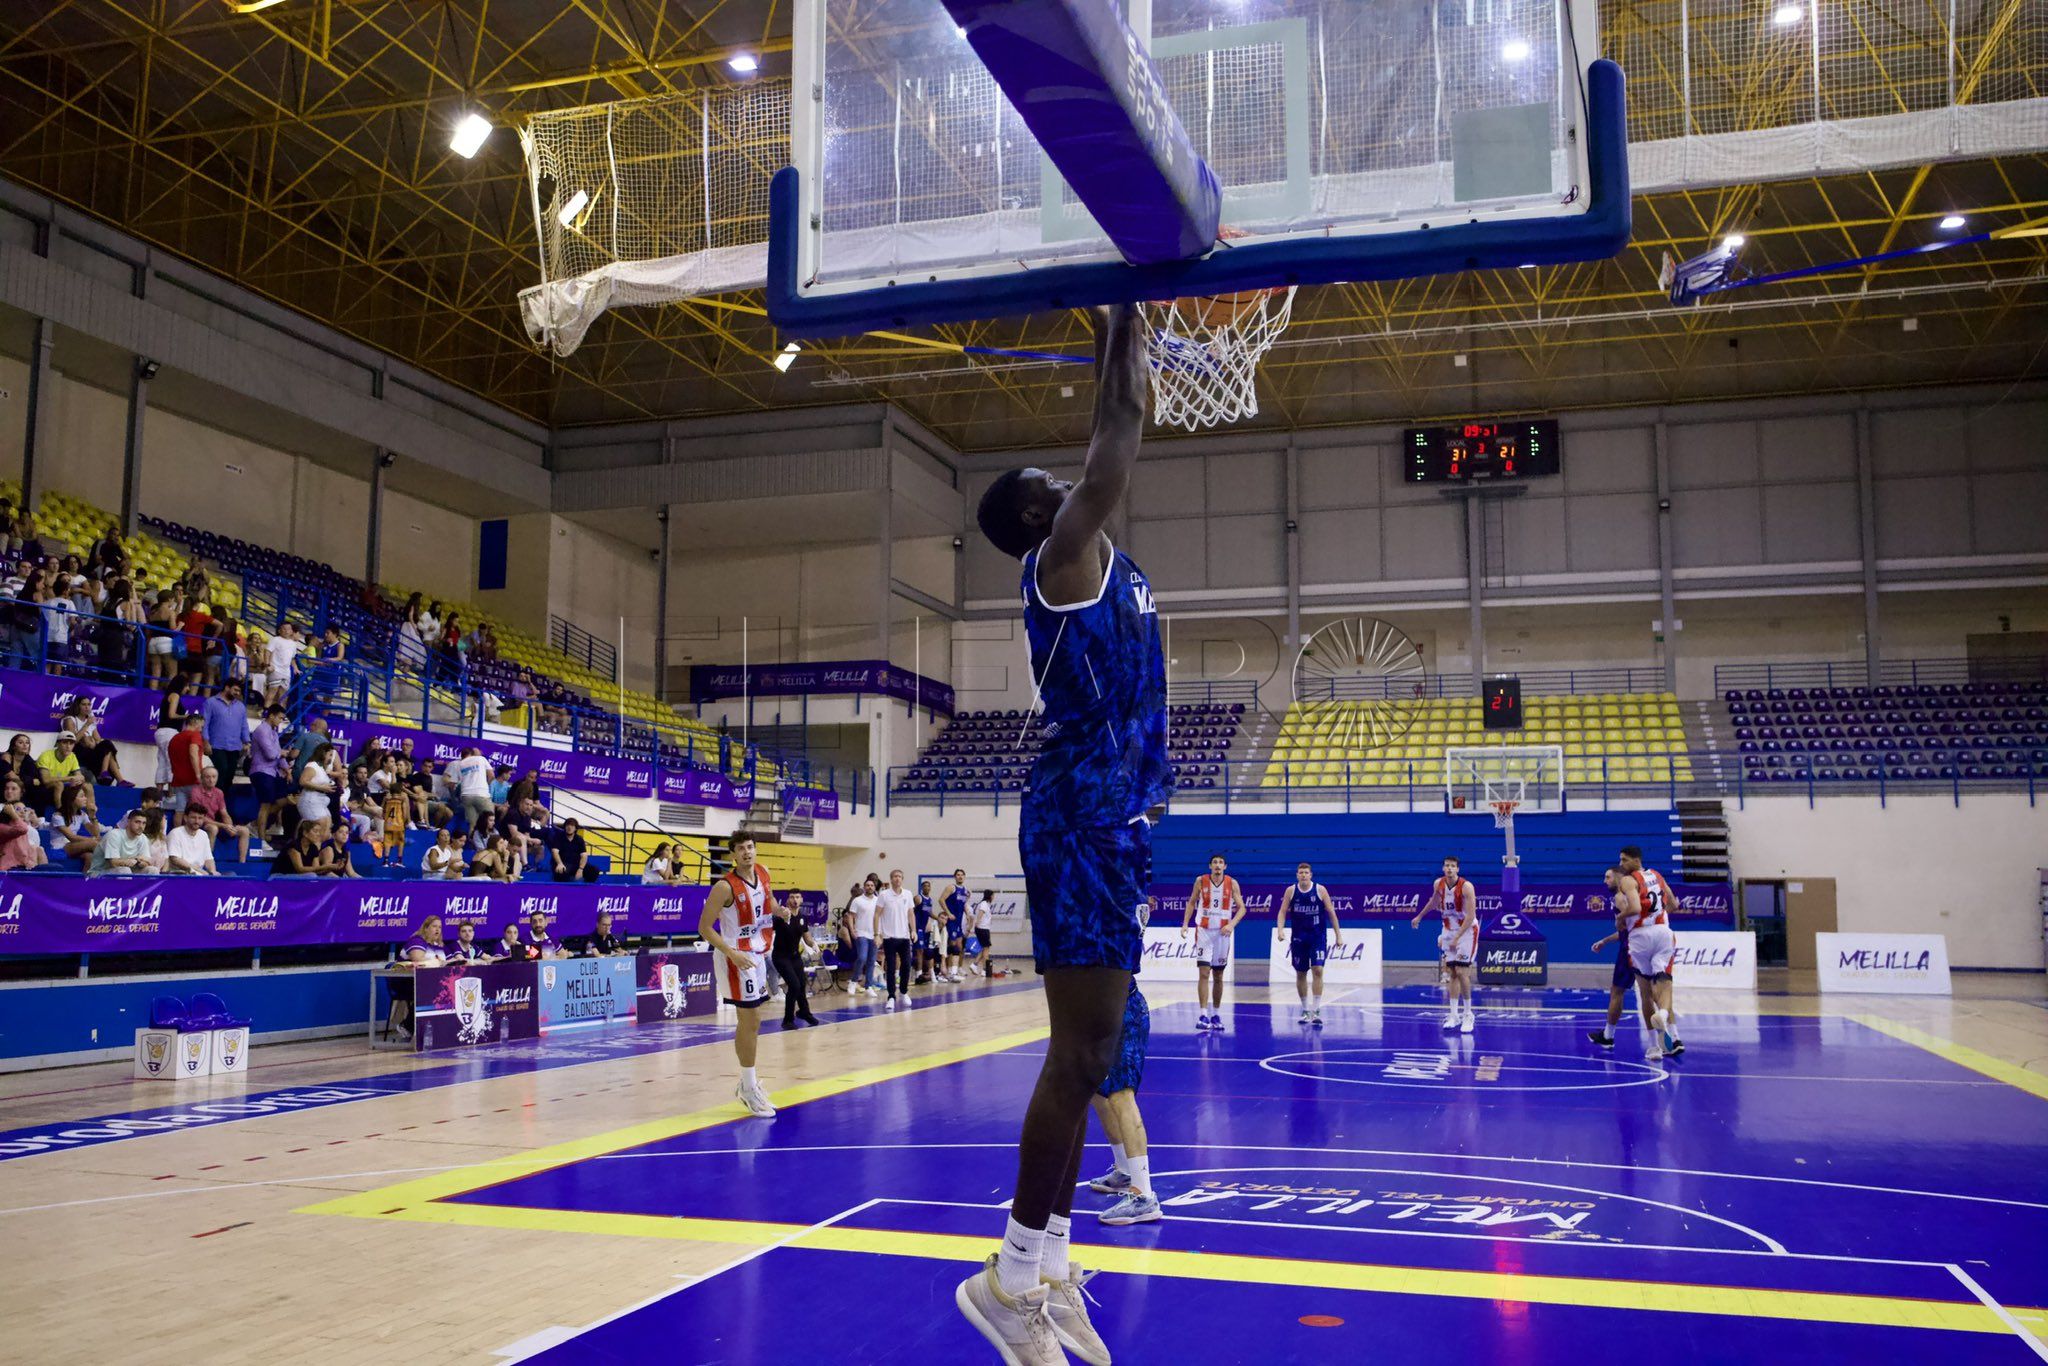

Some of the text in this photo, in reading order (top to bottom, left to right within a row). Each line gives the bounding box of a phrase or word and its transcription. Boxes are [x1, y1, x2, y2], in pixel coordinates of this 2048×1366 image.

[1452, 448, 1467, 461] 31
[1478, 442, 1485, 454] 3
[1500, 446, 1515, 458] 21
[1451, 463, 1458, 474] 0
[1505, 460, 1513, 471] 0
[824, 670, 869, 682] MELILLA
[51, 692, 110, 716] MELA
[1490, 697, 1513, 709] 21
[540, 760, 567, 774] MELILLA
[584, 765, 610, 779] MELILLA
[626, 770, 648, 783] MELILLA
[89, 895, 163, 920] MELILLA
[215, 896, 279, 918] MELILLA
[360, 896, 410, 916] MELILLA
[445, 896, 489, 915] MELILLA
[520, 897, 558, 914] MELILLA
[597, 896, 630, 912] MELILLA
[653, 897, 683, 913] MELILLA
[1213, 899, 1219, 908] 3
[1363, 894, 1419, 908] MELILLA
[755, 905, 761, 918] 6
[113, 924, 126, 933] DEL
[128, 923, 160, 933] DEPORTE
[1141, 942, 1199, 961] MELILL
[1198, 948, 1204, 956] 3
[1486, 950, 1537, 965] MELILLA
[1673, 948, 1737, 966] ELILLA
[1839, 950, 1930, 970] MELILLA
[580, 962, 599, 975] CLUB
[688, 972, 711, 986] MELILLA
[745, 979, 754, 993] 6
[495, 986, 531, 1004] MELILLA
[566, 978, 612, 999] MELILLA
[1196, 1181, 1596, 1209] CIUDAD DEL DEPORTE
[1160, 1189, 1591, 1229] MELILLA
